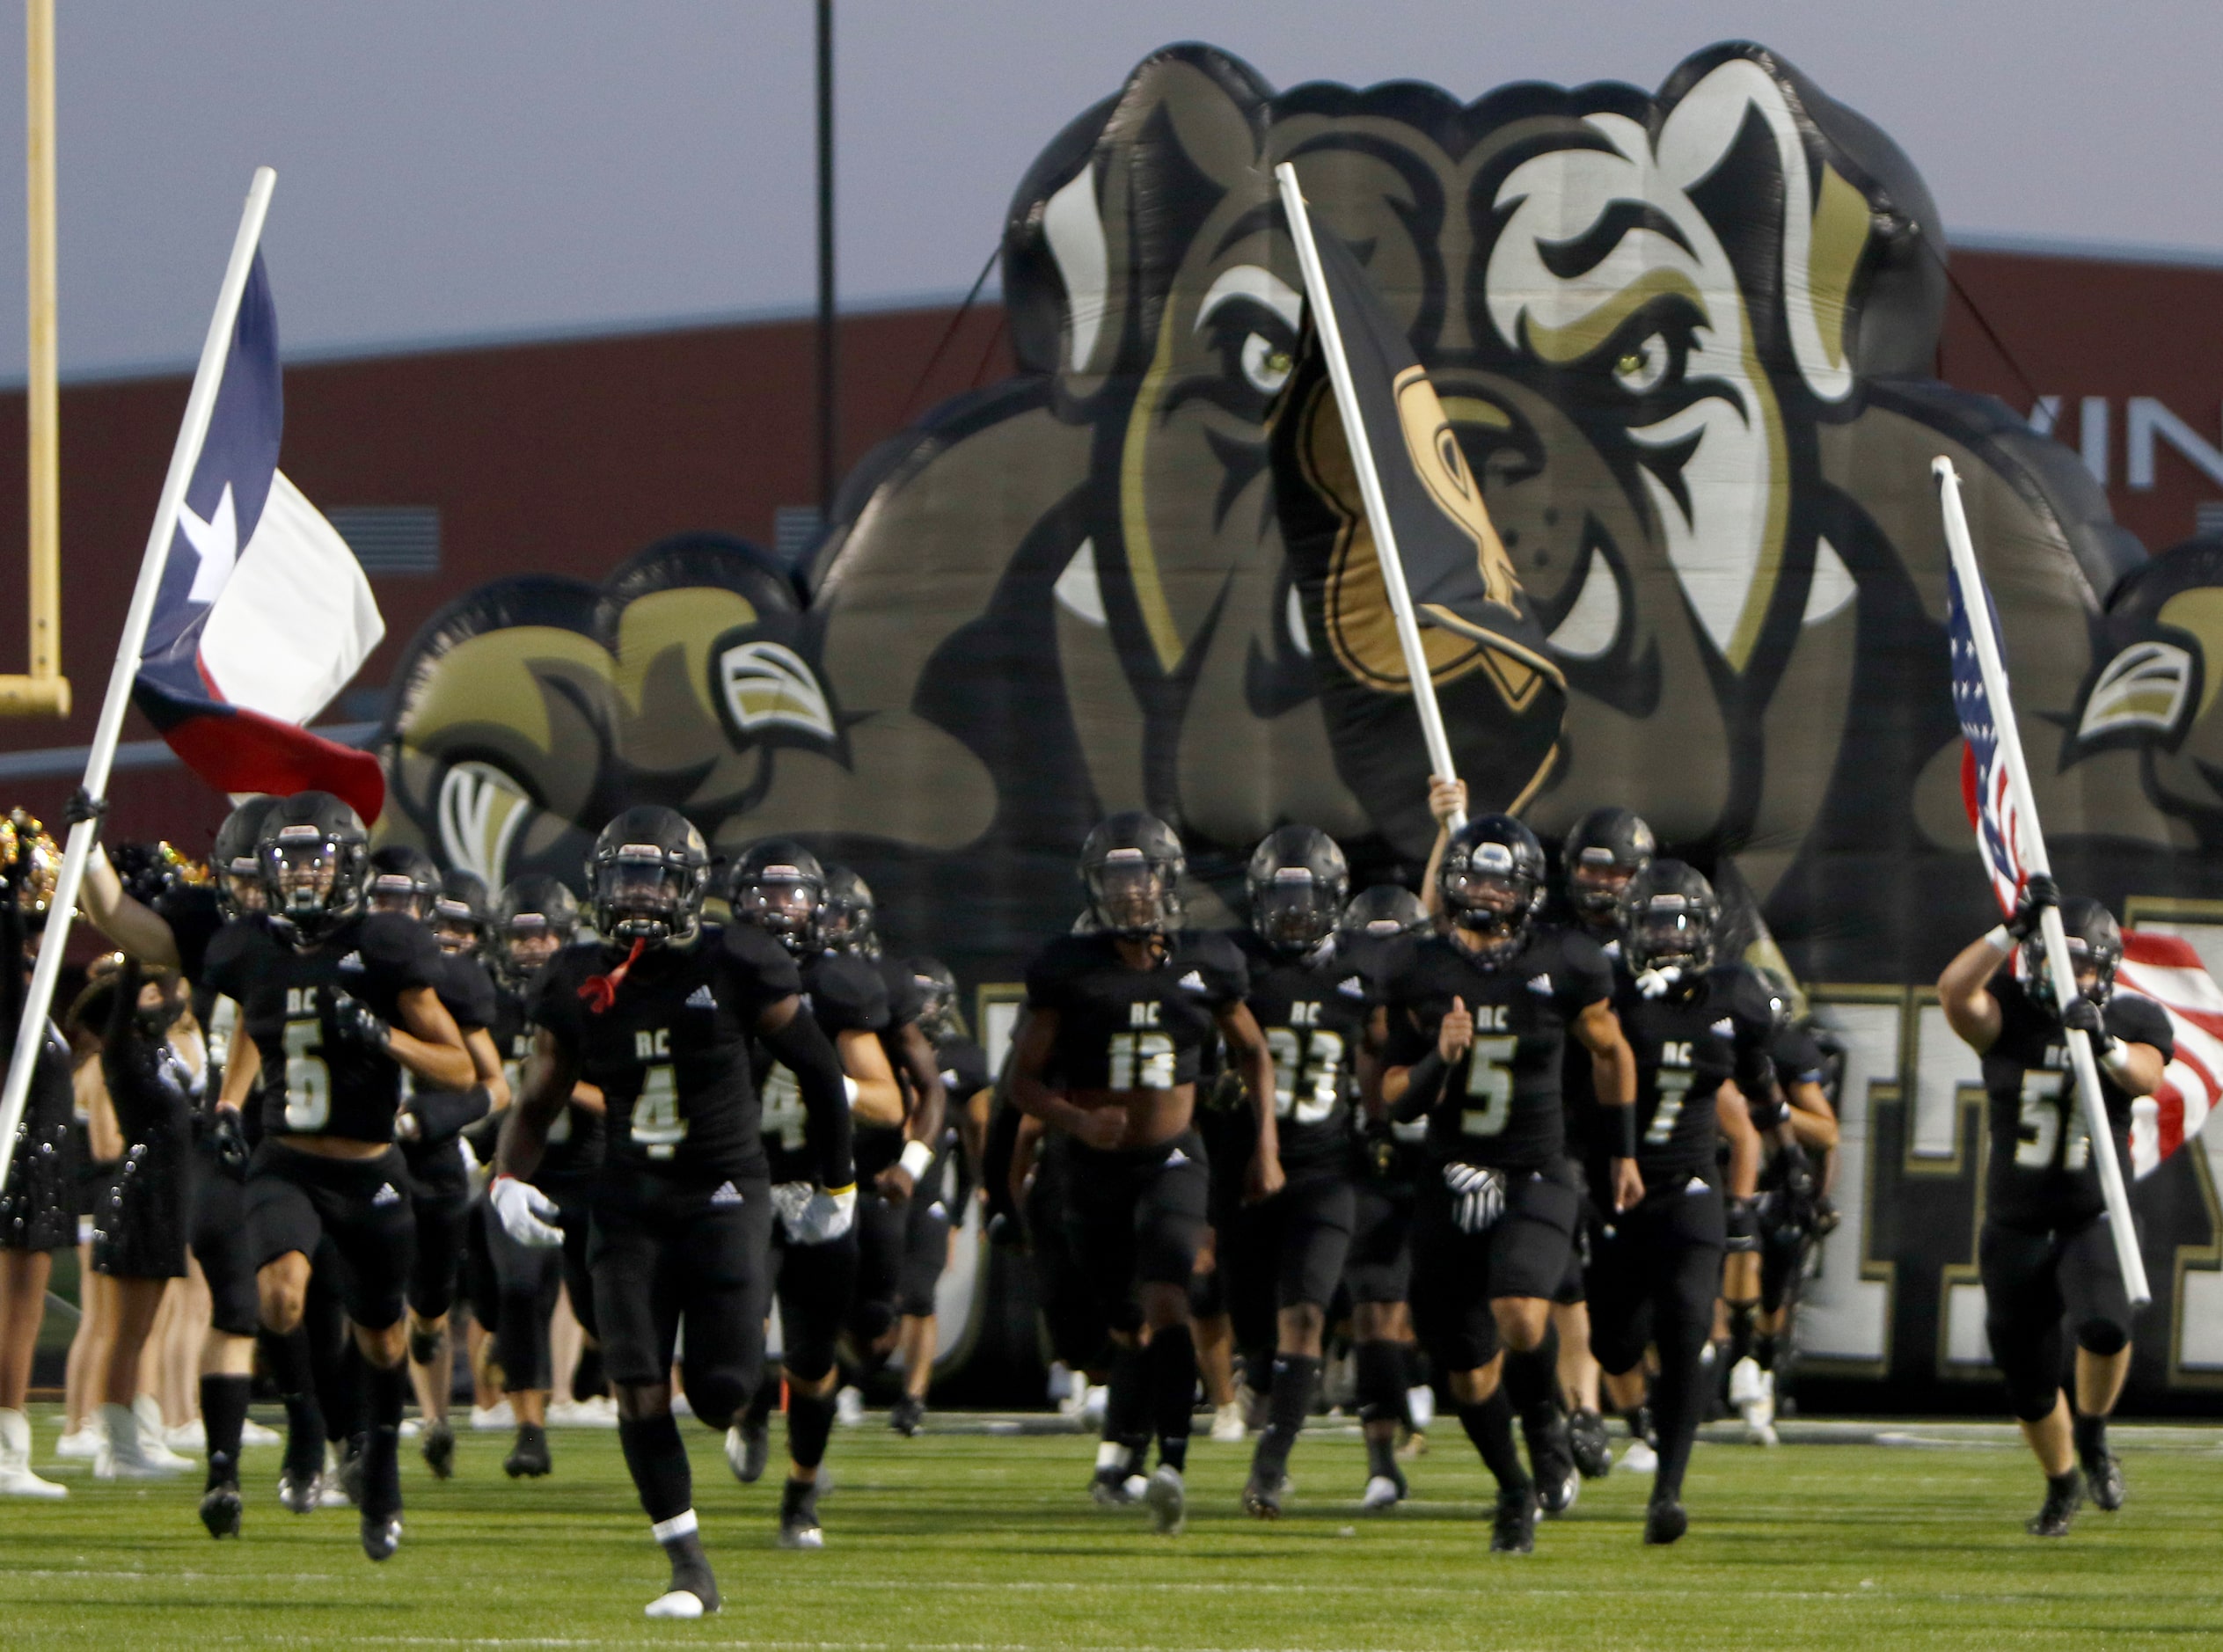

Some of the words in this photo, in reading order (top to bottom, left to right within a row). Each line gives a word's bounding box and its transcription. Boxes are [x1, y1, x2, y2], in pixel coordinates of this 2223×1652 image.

[630, 1064, 689, 1160] 4
[1460, 1034, 1518, 1136] 5
[1644, 1068, 1697, 1144] 7
